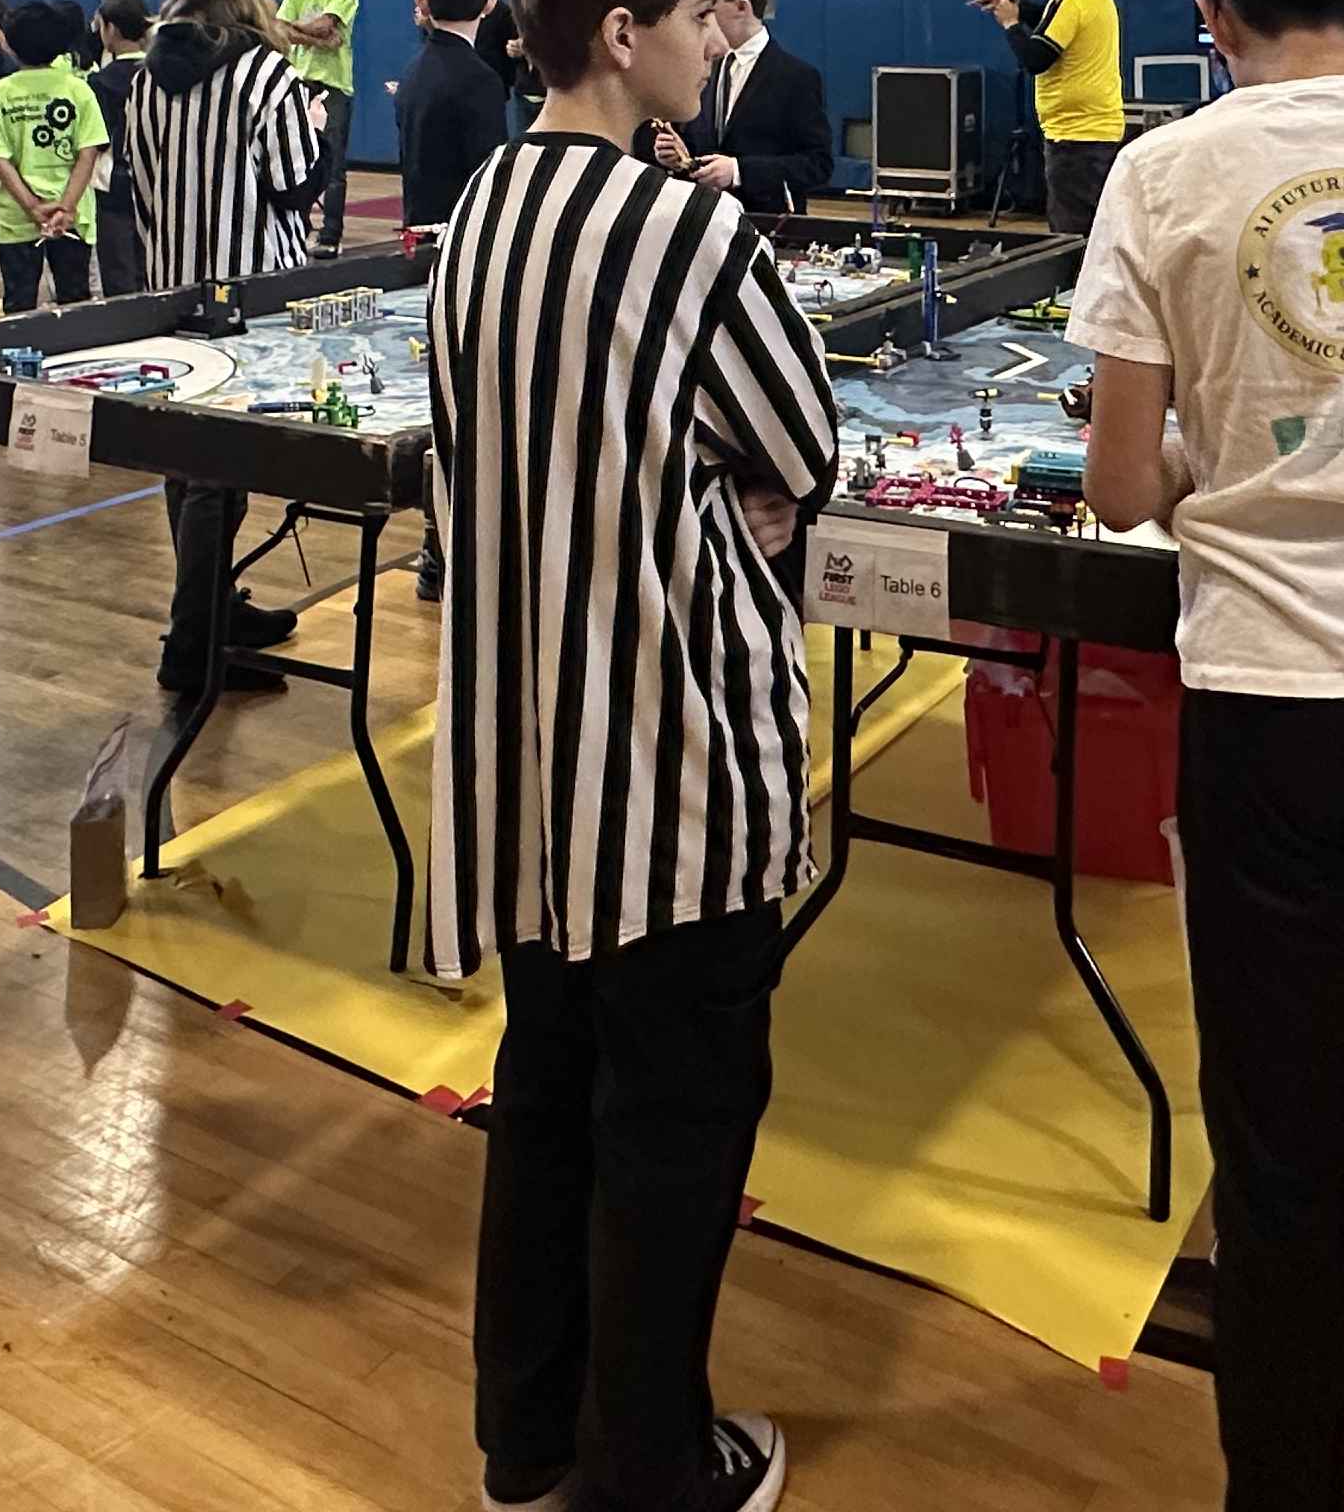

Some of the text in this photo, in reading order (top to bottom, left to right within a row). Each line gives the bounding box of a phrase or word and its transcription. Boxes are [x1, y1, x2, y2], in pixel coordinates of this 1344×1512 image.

[1254, 214, 1274, 239] AI
[1253, 290, 1336, 359] ACADEMIC
[50, 428, 87, 448] Table 5
[822, 571, 855, 585] FIRST
[824, 582, 851, 594] LEGO
[879, 574, 942, 599] Table 6
[819, 591, 857, 606] LEAGUE
